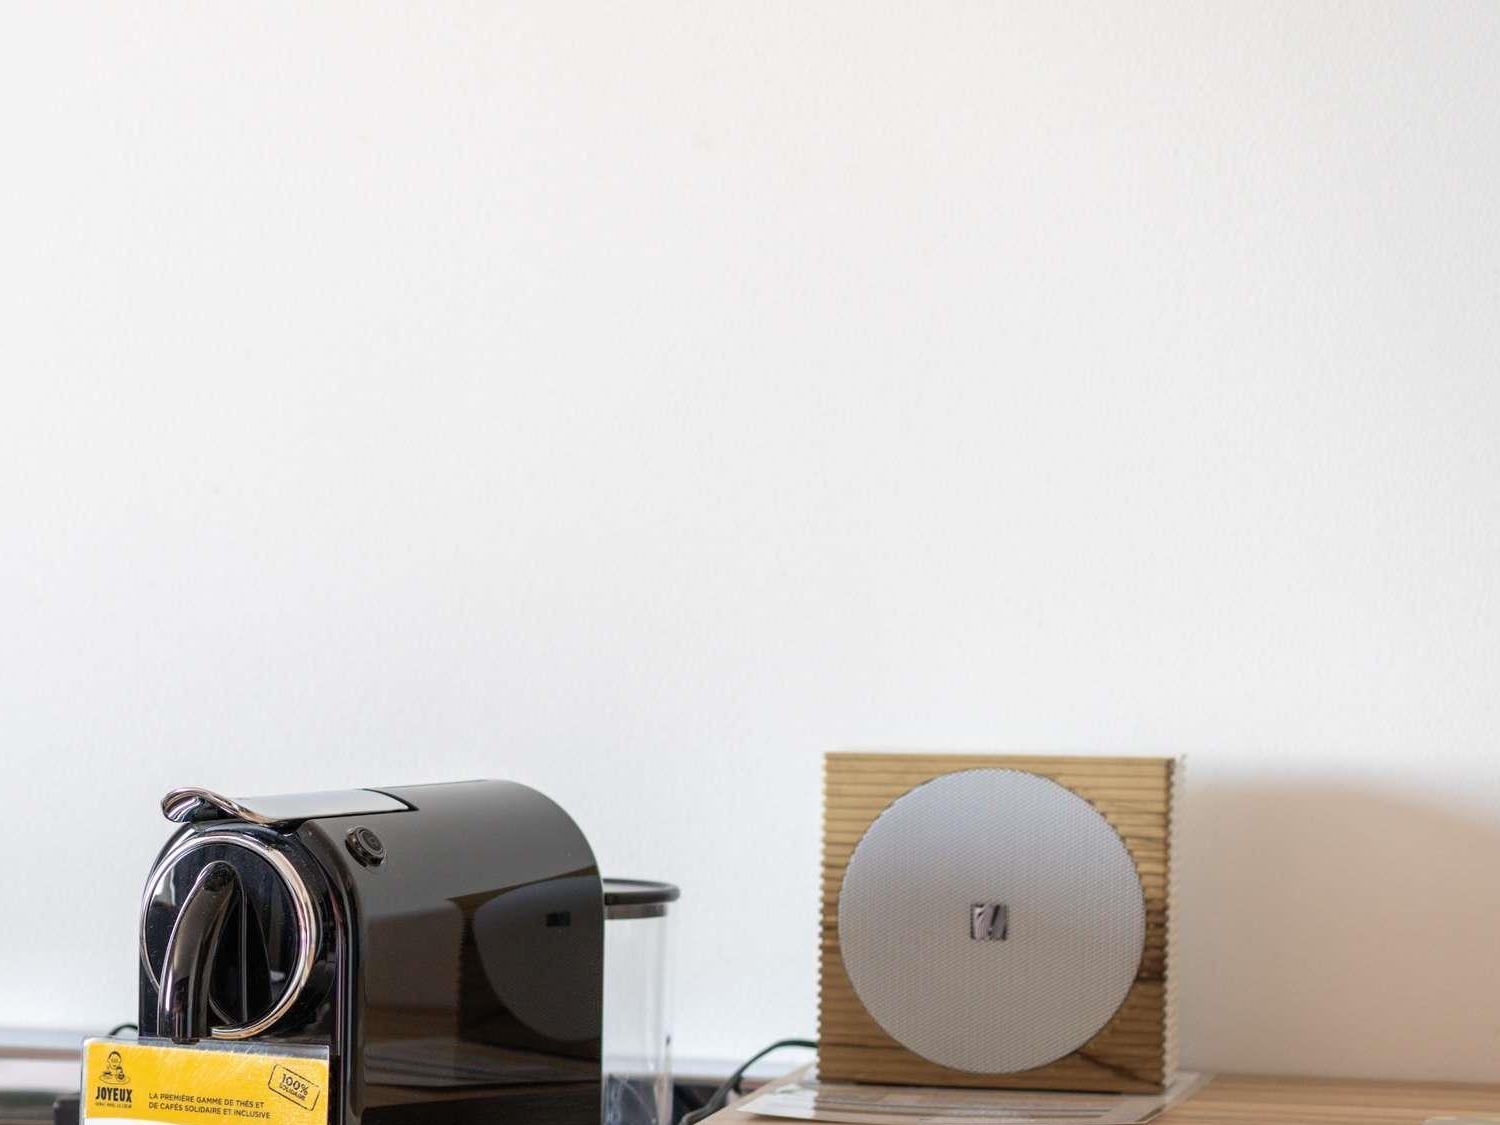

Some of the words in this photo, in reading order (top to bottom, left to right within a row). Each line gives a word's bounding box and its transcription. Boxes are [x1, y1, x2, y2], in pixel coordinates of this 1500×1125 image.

[282, 1073, 308, 1096] 100%
[95, 1086, 132, 1103] JOYEUX
[149, 1092, 158, 1100] LA
[160, 1093, 194, 1103] PREMIÈRE
[196, 1096, 221, 1105] GAMME
[236, 1099, 253, 1108] THÉS
[255, 1101, 264, 1109] ET
[160, 1102, 183, 1111] CAFÉS
[185, 1105, 221, 1115] SOLIDAIRE
[223, 1108, 231, 1116] ET
[233, 1109, 271, 1119] INCLUSIVE
